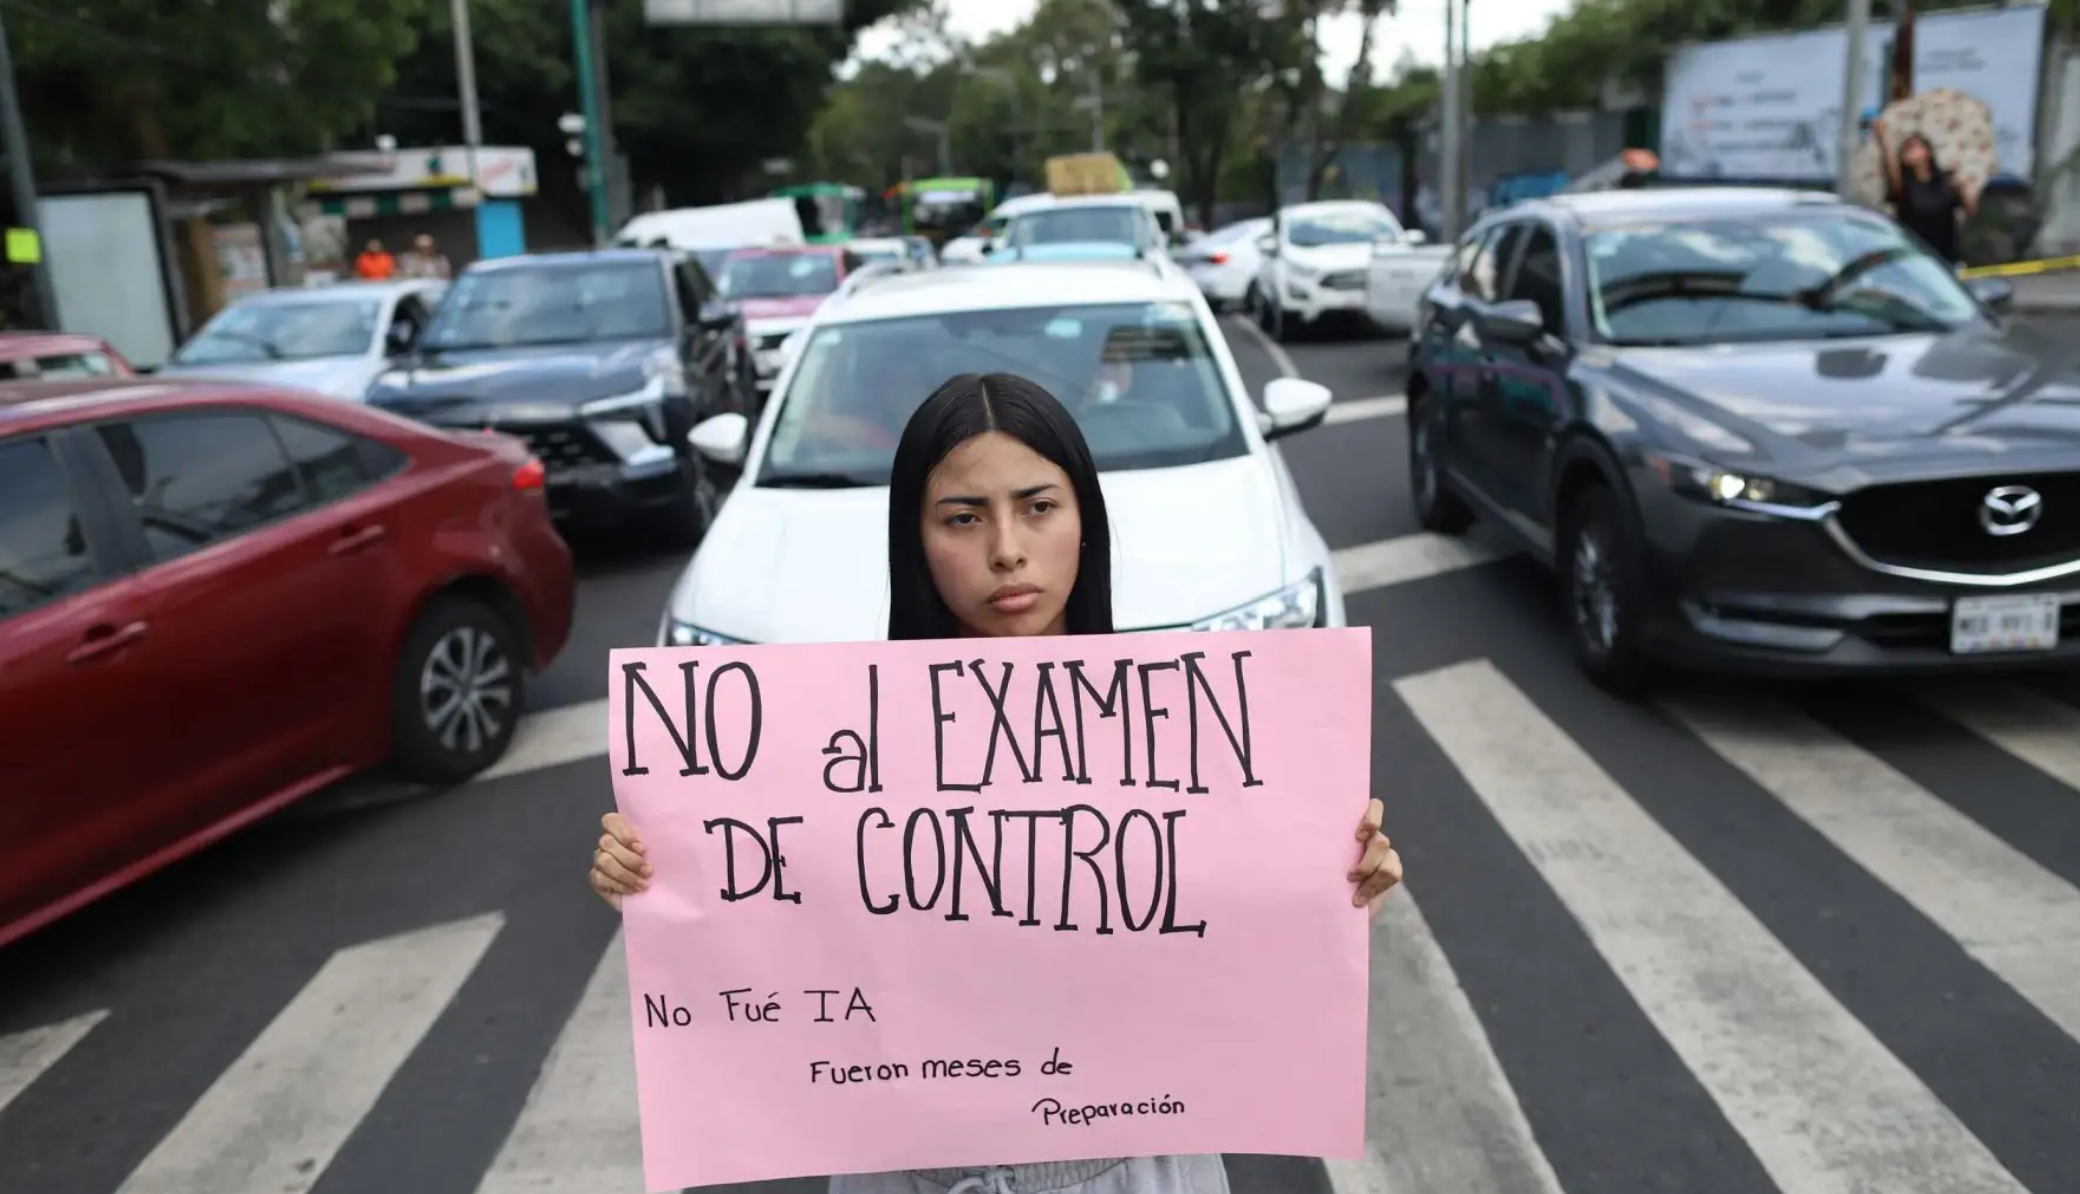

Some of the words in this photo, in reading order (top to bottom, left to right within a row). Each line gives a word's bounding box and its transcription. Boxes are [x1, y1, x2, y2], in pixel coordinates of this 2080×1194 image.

[621, 660, 762, 781] NO
[821, 664, 884, 794] al
[928, 650, 1264, 794] EXAMEN
[702, 815, 804, 905] DE
[856, 803, 1208, 939] CONTROL
[643, 993, 692, 1028] No
[718, 987, 782, 1023] Fué
[803, 986, 877, 1023] IA
[809, 1060, 909, 1085] Fueron
[921, 1058, 1022, 1079] meses
[1040, 1046, 1073, 1076] de
[1031, 1093, 1185, 1126] Preparación
